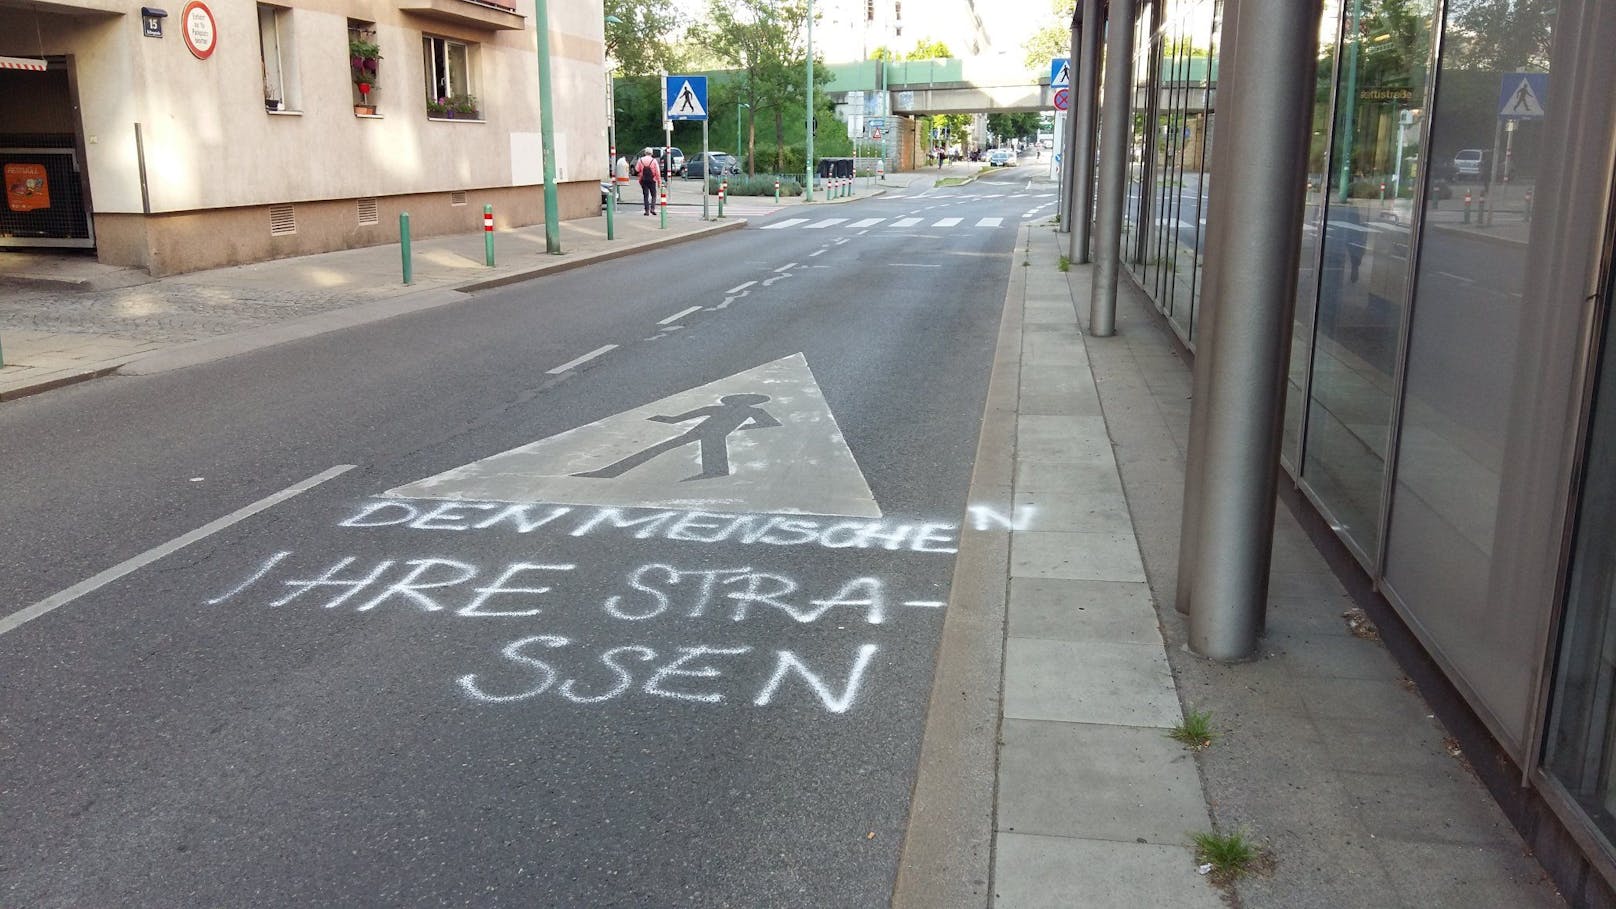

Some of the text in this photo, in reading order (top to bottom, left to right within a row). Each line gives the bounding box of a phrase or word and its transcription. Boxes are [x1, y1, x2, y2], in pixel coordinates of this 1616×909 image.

[148, 18, 158, 30] 15
[337, 500, 1036, 554] DEN MENSCHEN
[206, 550, 577, 617] IHRE
[456, 633, 879, 714] SSEN
